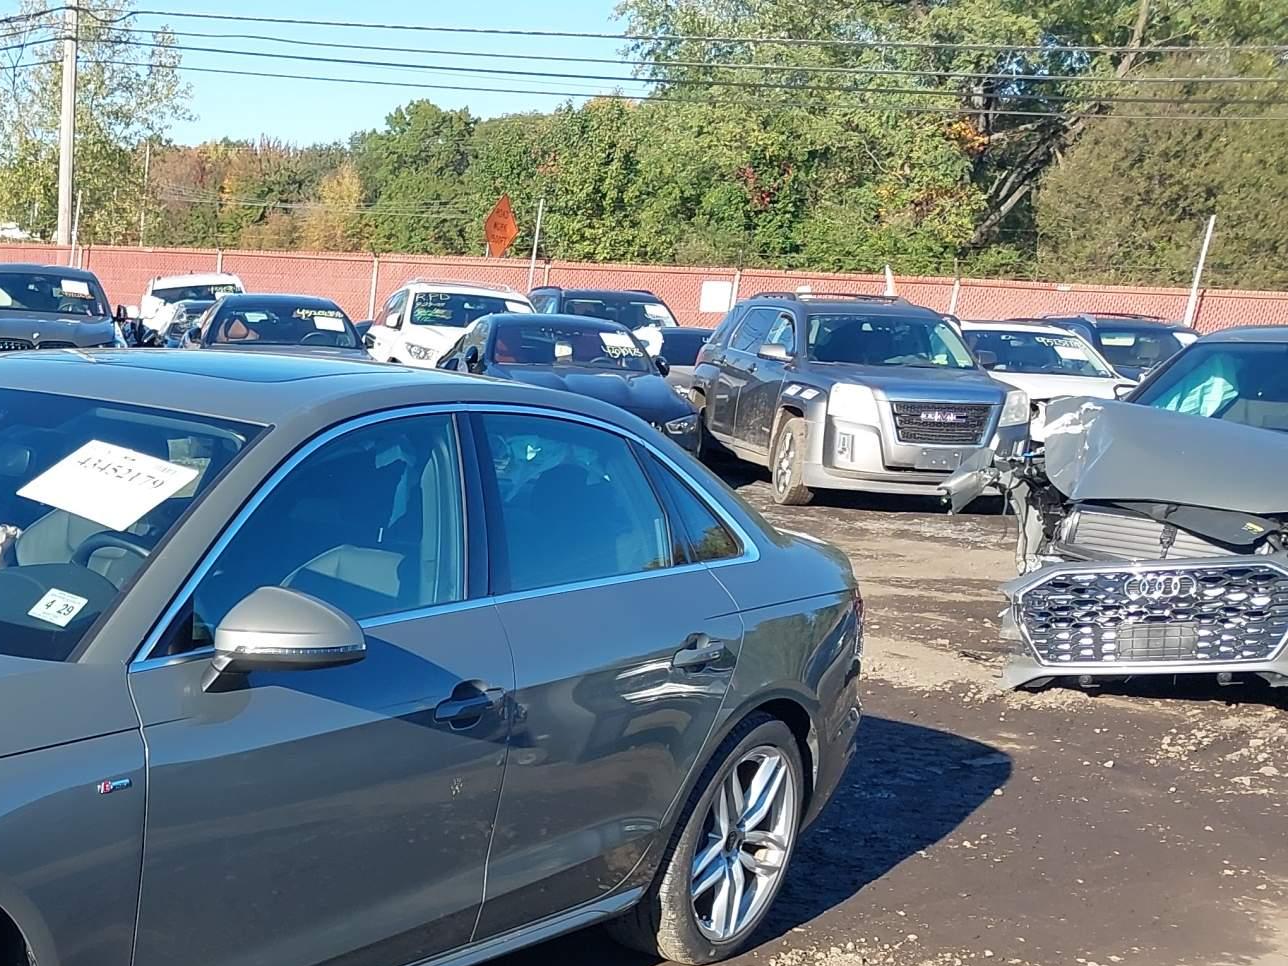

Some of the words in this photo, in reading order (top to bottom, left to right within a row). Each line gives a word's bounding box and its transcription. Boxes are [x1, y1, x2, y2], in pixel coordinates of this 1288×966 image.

[920, 410, 967, 423] GMC
[77, 455, 166, 489] 43452179
[44, 599, 57, 610] 4
[56, 603, 75, 616] 29
